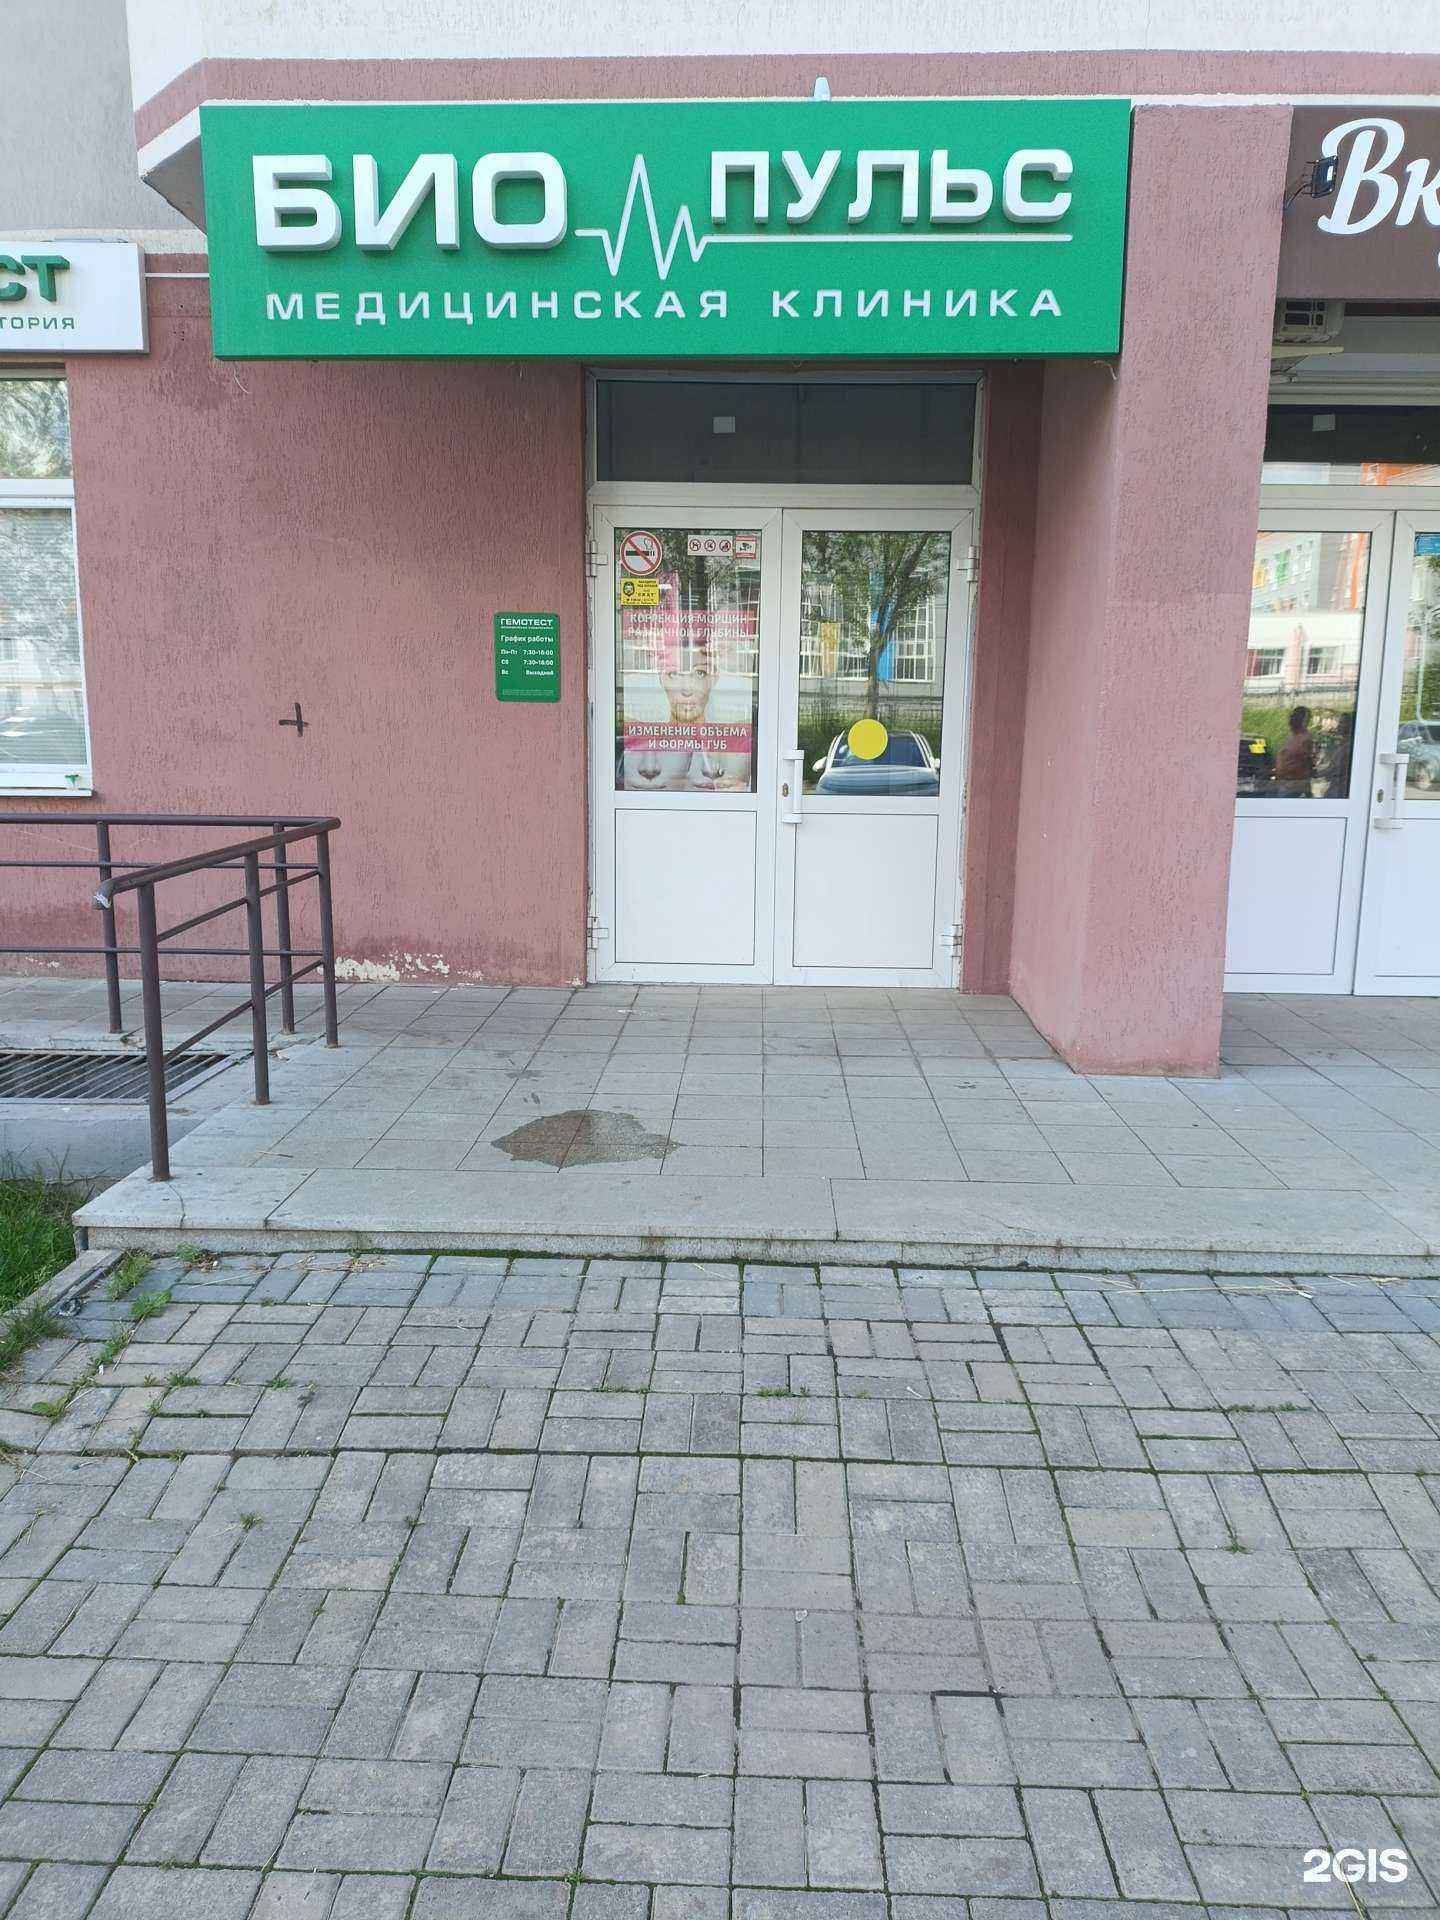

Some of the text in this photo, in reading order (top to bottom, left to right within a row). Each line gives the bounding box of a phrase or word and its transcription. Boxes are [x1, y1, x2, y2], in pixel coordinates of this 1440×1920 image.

[253, 149, 1073, 251] БИО ПУЛЬС
[266, 289, 1062, 325] МЕДИЦИНСКАЯ КЛИНИКА
[500, 618, 553, 626] ГЕМОТЕСТ
[630, 614, 747, 624] КОРРЕКЦИЯ МОРЩИН
[500, 635, 527, 643] График
[628, 725, 748, 737] ИЗМЕНЕНИЕ ОБЪЕМА
[648, 739, 727, 750] И ФОРМЫ ГУБ
